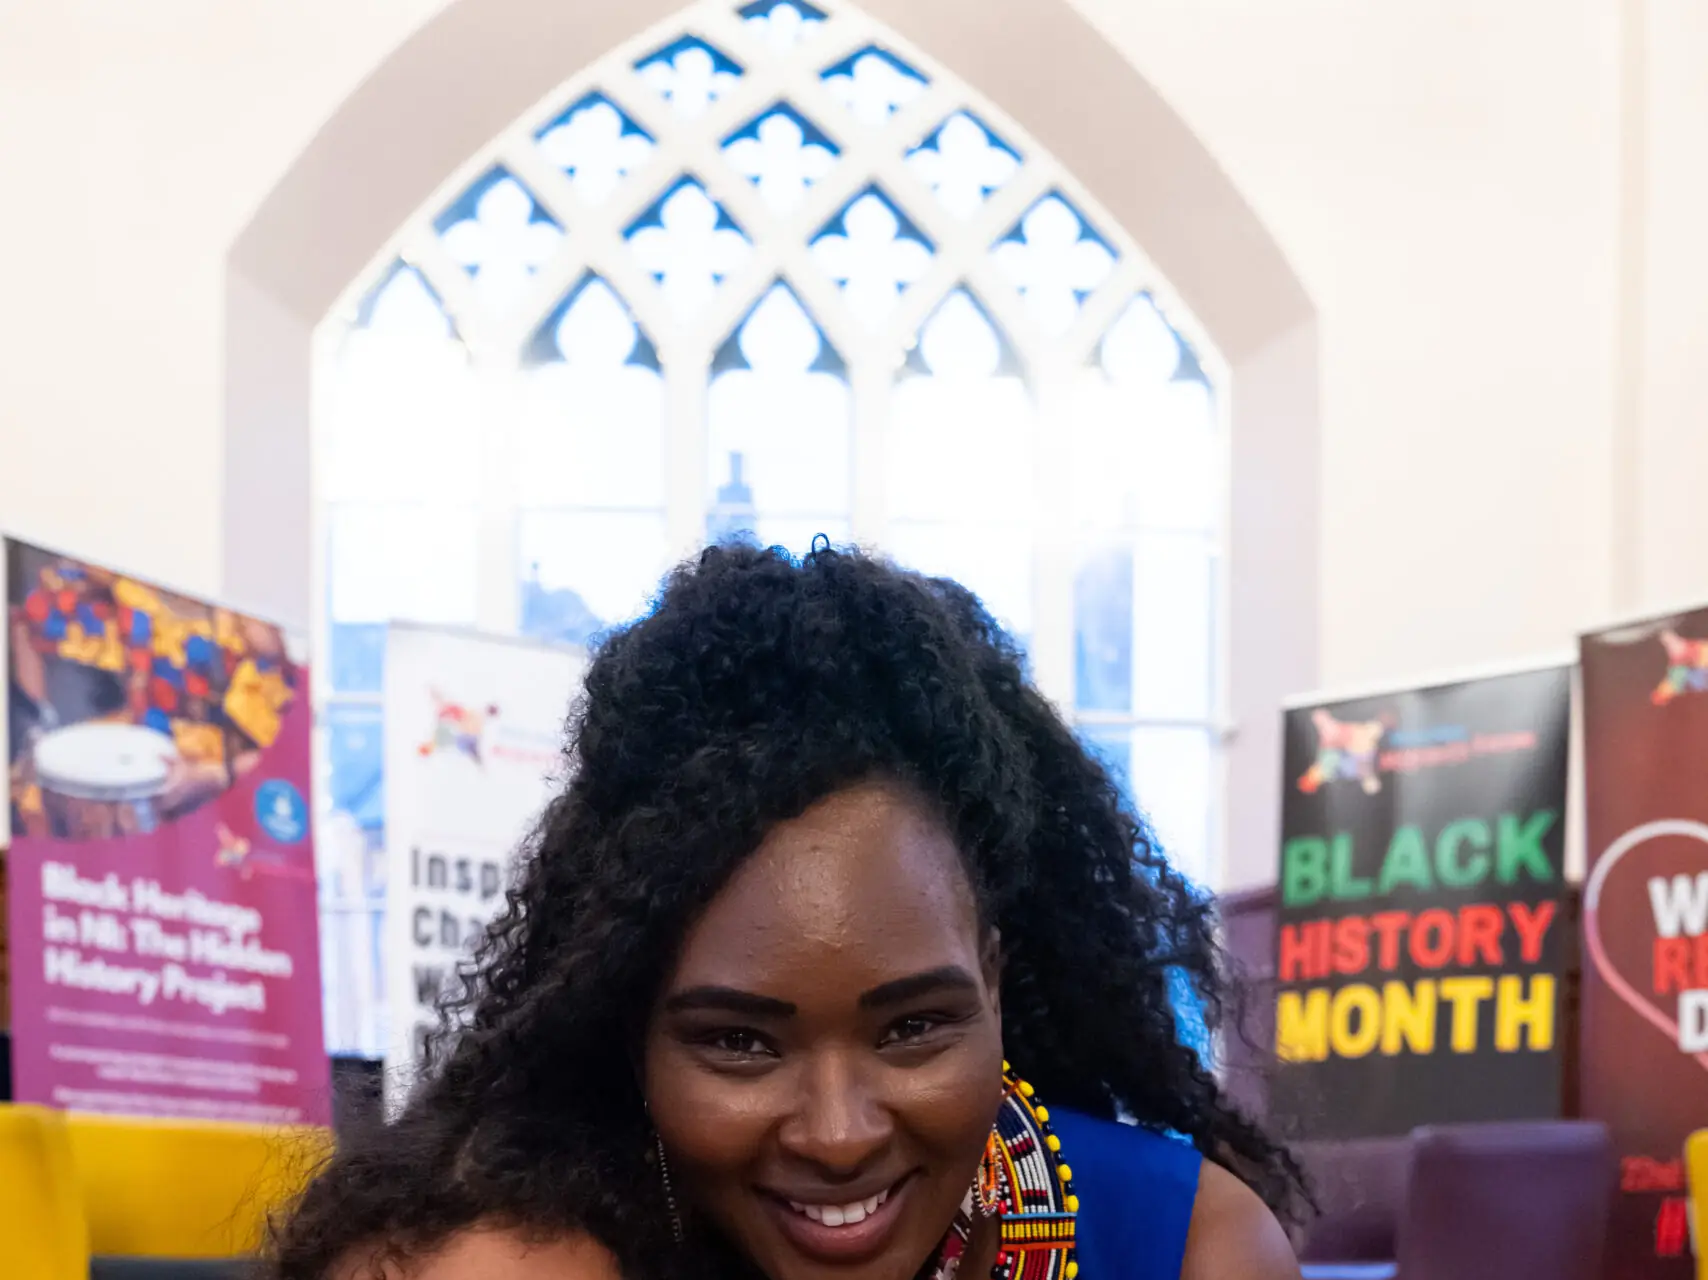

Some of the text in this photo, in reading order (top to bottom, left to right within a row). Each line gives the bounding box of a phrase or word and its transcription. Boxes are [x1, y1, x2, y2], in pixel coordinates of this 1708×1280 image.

[411, 847, 501, 899] Insp
[1282, 810, 1556, 907] BLACK
[413, 905, 487, 949] Cha
[1647, 870, 1708, 938] W
[130, 918, 188, 959] The
[1278, 901, 1556, 981] HISTORY
[44, 946, 266, 1015] History Project
[1276, 974, 1555, 1063] MONTH
